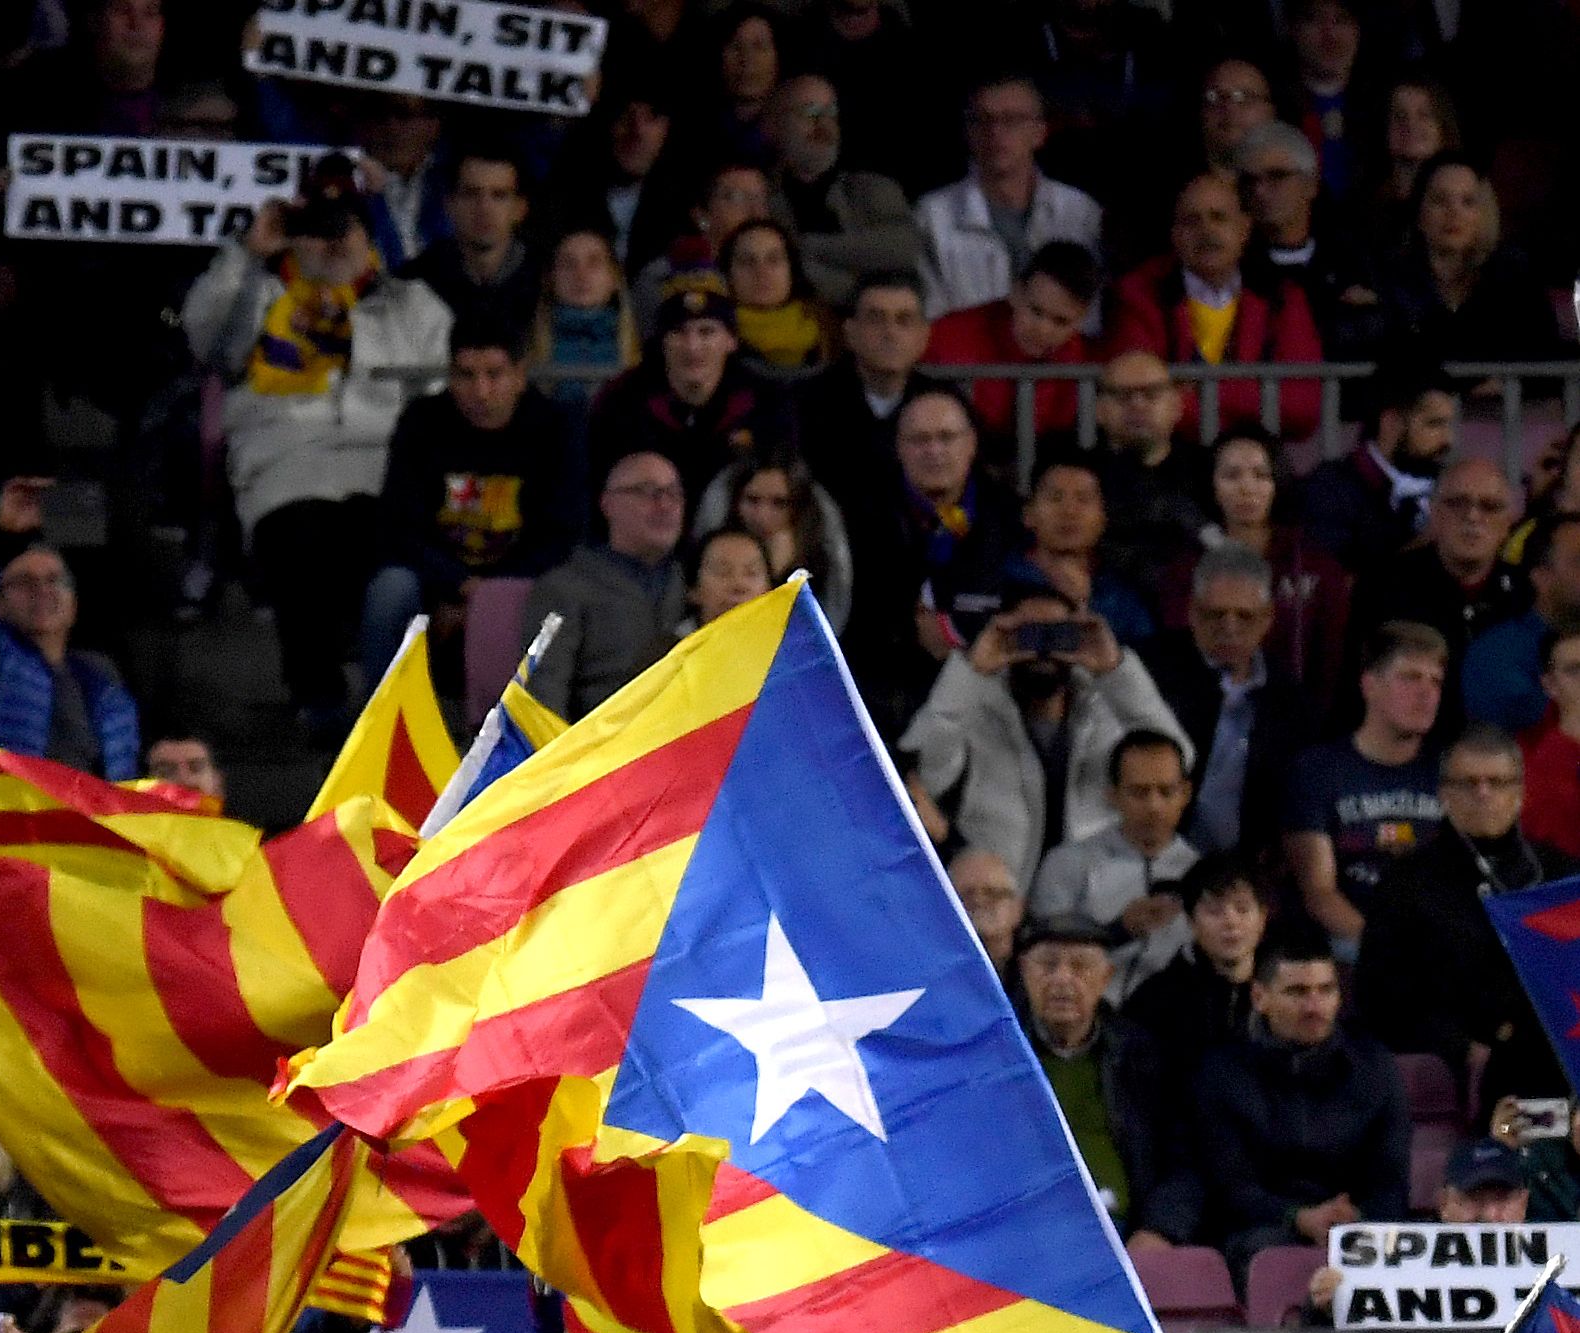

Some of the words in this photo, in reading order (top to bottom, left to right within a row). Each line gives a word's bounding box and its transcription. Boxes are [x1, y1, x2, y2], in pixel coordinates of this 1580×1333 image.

[494, 12, 592, 55] SIT
[260, 33, 398, 82] AND
[416, 54, 587, 106] TALK
[18, 142, 235, 192] SPAIN,
[21, 200, 164, 233] AND
[183, 204, 256, 238] TA
[1346, 1287, 1498, 1322] AND
